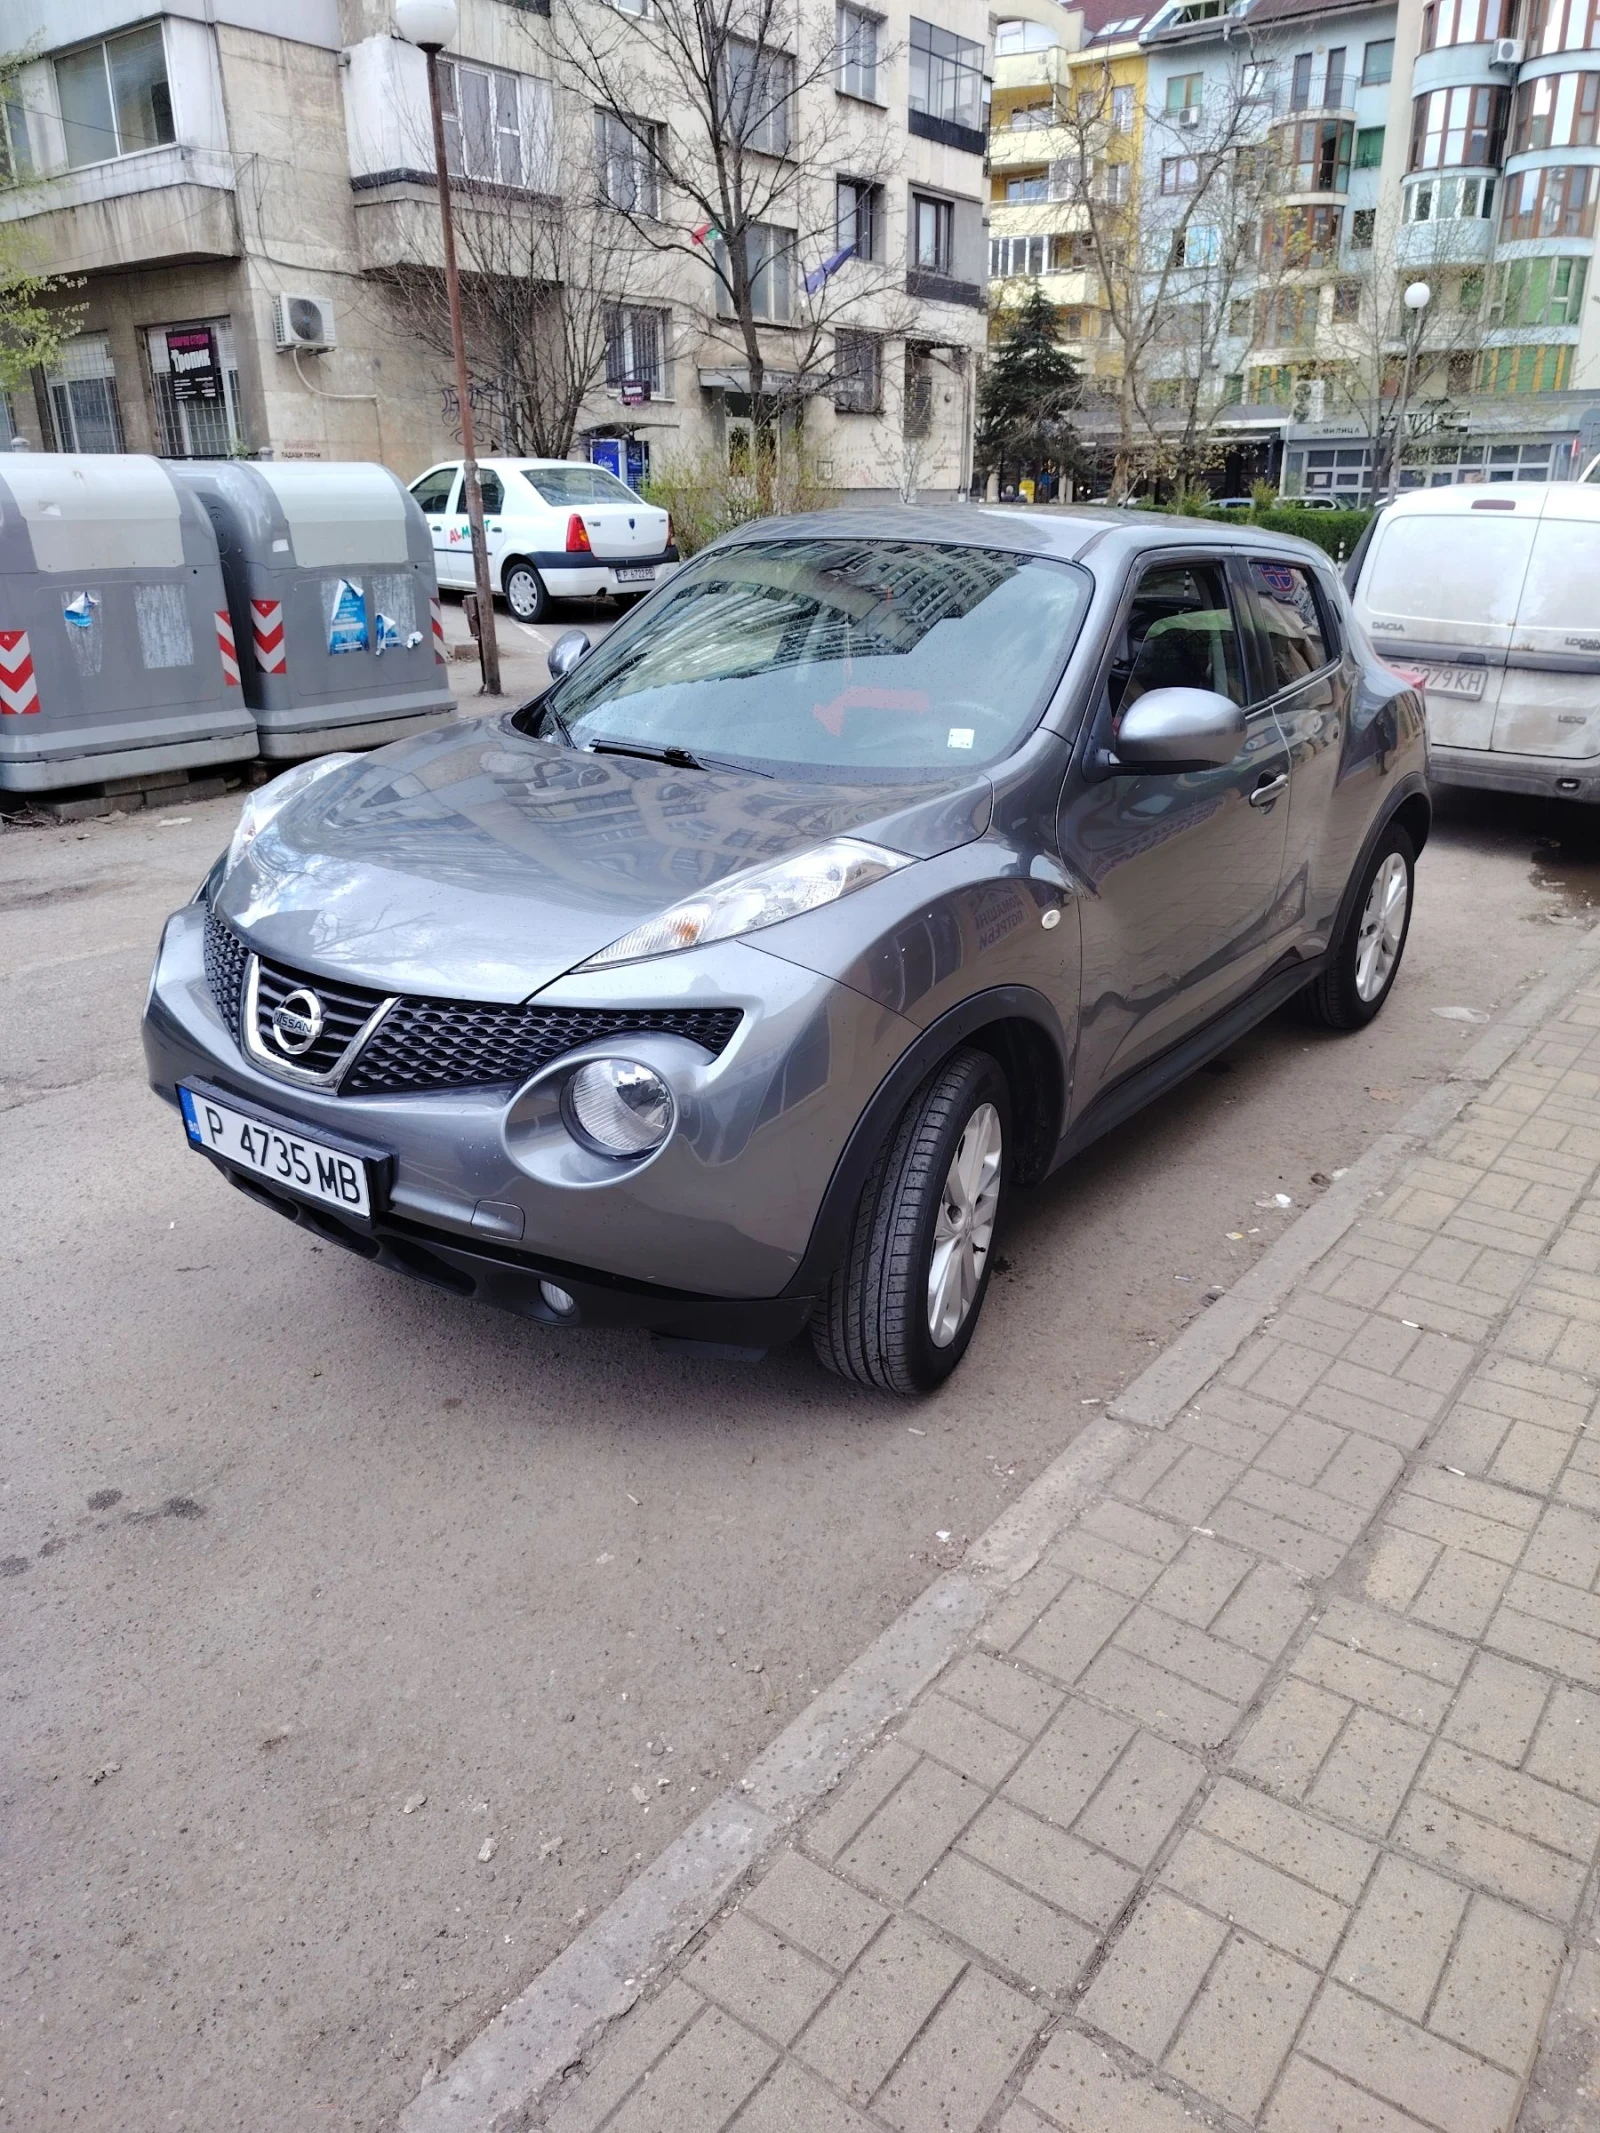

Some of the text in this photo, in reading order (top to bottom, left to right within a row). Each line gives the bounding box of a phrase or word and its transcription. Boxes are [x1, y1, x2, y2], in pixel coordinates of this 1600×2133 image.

[450, 520, 490, 544] ALMT
[1372, 621, 1405, 632] DACIA
[275, 1011, 313, 1033] NISSAN
[188, 1119, 200, 1135] BG
[205, 1106, 223, 1145] P
